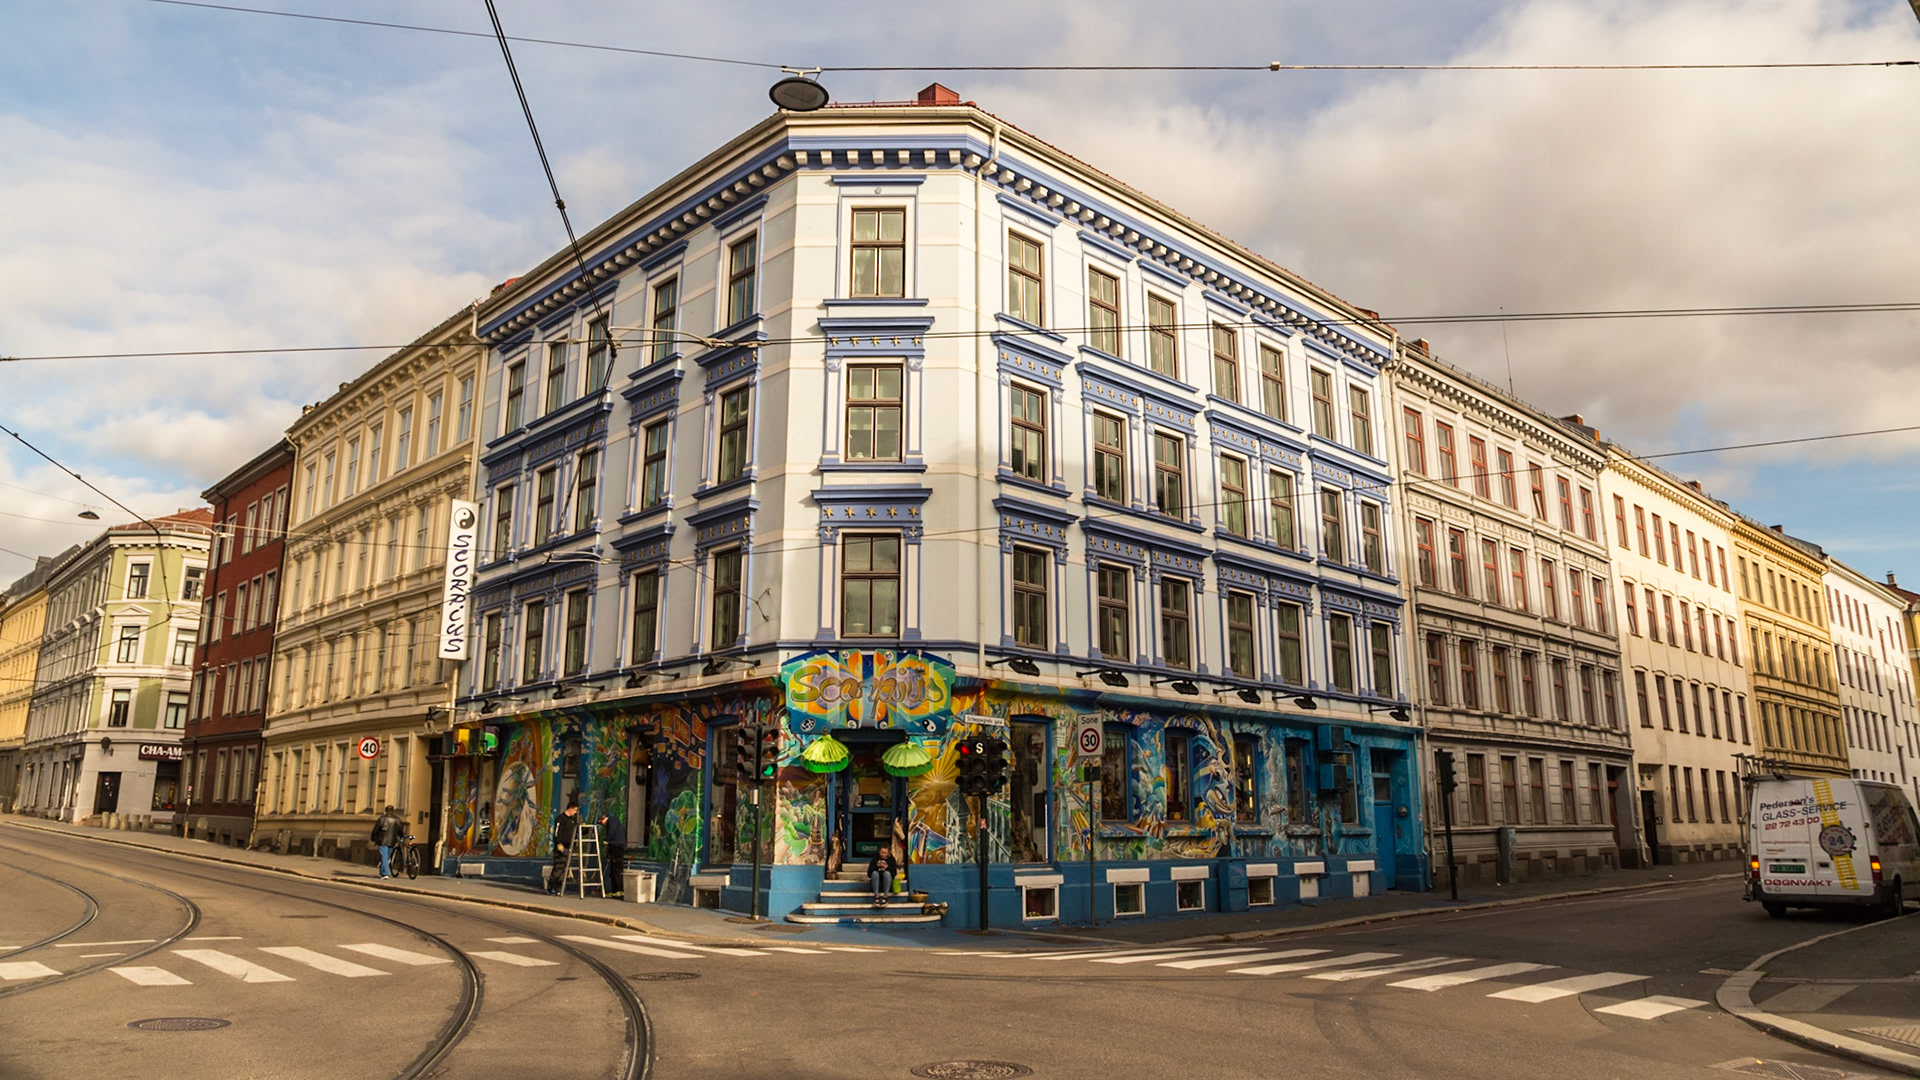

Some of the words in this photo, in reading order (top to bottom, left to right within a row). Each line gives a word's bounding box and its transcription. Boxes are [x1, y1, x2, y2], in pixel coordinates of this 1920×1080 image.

[790, 665, 945, 719] Scorpius
[1081, 716, 1098, 724] Sone
[1084, 734, 1096, 747] 30
[141, 745, 182, 757] CHA-AM
[361, 741, 377, 755] 40
[975, 740, 984, 754] S
[1762, 801, 1847, 821] GLASS-SERVICE
[1807, 816, 1820, 824] 00
[1828, 836, 1845, 846] 24
[1764, 879, 1832, 887] DØGNVAKT
